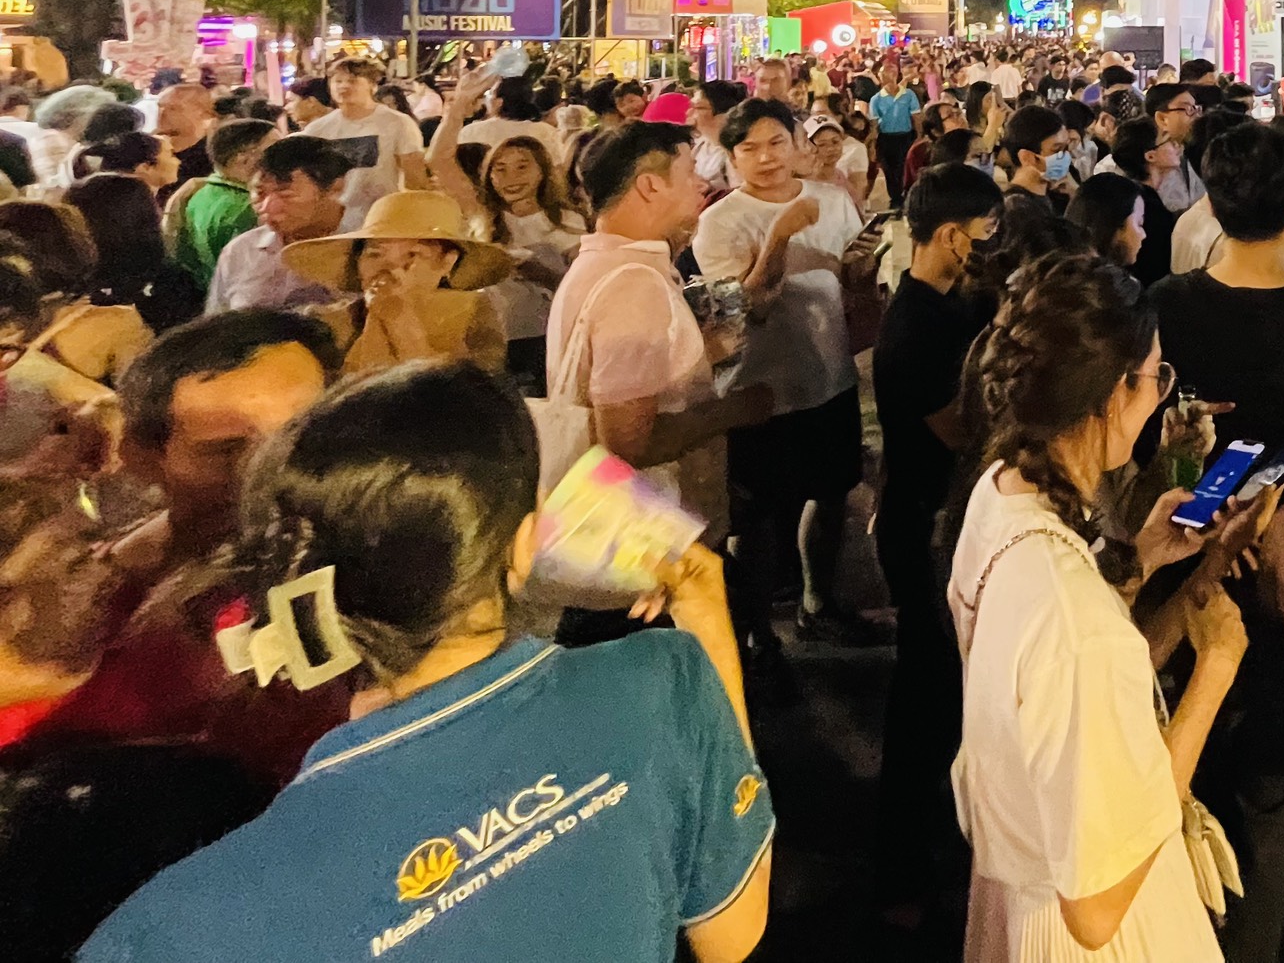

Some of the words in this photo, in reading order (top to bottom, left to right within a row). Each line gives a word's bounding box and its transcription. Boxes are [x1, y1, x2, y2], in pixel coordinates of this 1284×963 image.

[450, 15, 515, 32] FESTIVAL
[457, 773, 564, 852] VACS
[371, 907, 435, 957] Meals
[438, 871, 487, 914] from
[489, 830, 554, 879] wheels
[555, 814, 577, 835] to
[578, 781, 629, 821] wings
